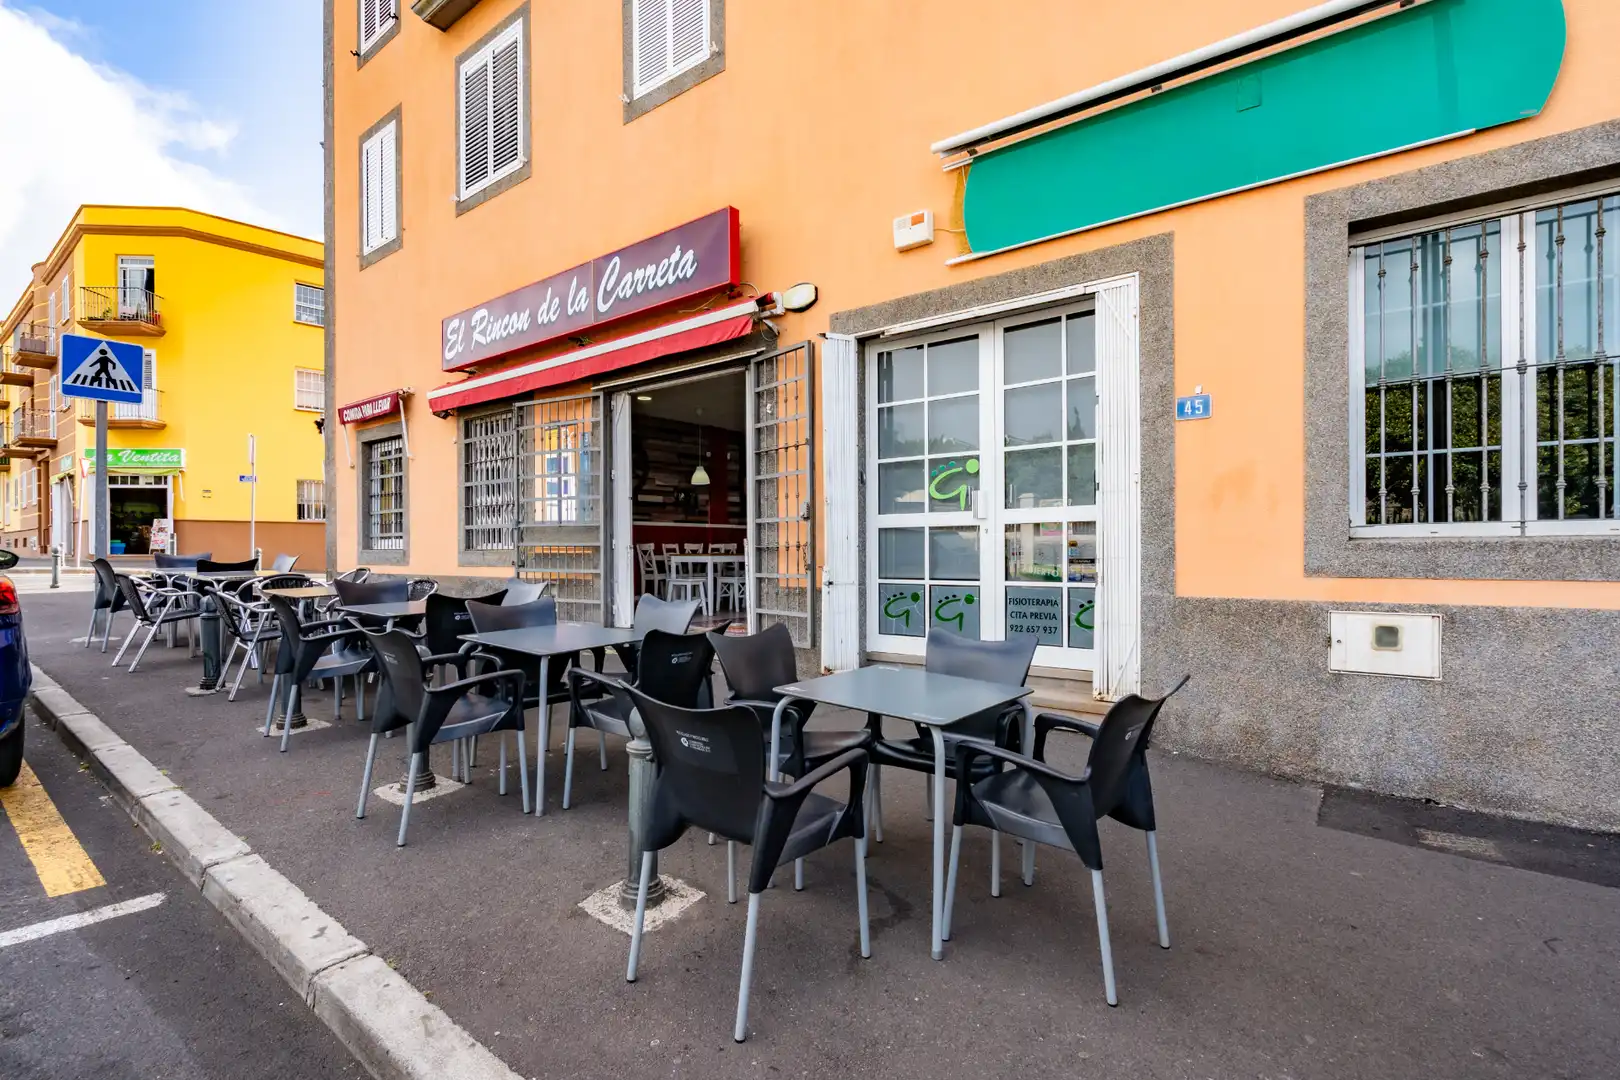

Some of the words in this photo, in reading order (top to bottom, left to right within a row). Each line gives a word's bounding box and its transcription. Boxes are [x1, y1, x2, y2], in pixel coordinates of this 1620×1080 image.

[445, 317, 465, 360] El
[471, 307, 531, 350] Rincon
[537, 286, 560, 325] de
[567, 275, 589, 316] la
[597, 244, 697, 313] Carreta
[373, 397, 391, 414] LLEVAR
[1184, 400, 1203, 415] 45
[118, 449, 180, 464] Ventita
[1008, 597, 1059, 607] FISIOTERAPIA
[1010, 610, 1028, 619] CITA
[1030, 611, 1057, 620] PREVIA
[1009, 624, 1024, 633] 922
[1026, 625, 1040, 633] 657
[1042, 626, 1058, 635] 937
